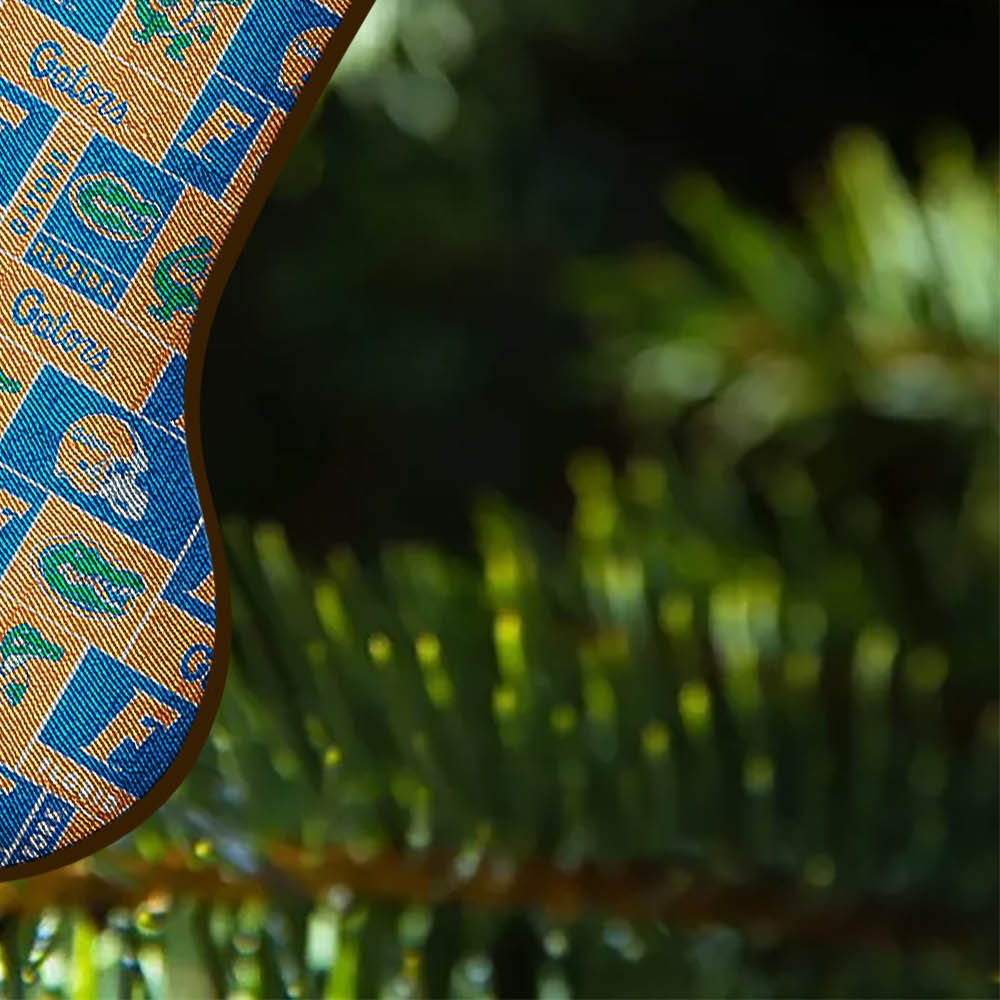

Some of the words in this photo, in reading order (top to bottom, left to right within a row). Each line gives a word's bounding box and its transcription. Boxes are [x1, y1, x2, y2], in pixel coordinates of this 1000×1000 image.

[29, 42, 126, 125] Gators
[178, 99, 254, 162] F
[7, 149, 72, 238] GATORS
[30, 237, 117, 300] FLORIDA
[12, 289, 107, 371] Gators
[80, 687, 181, 771] F
